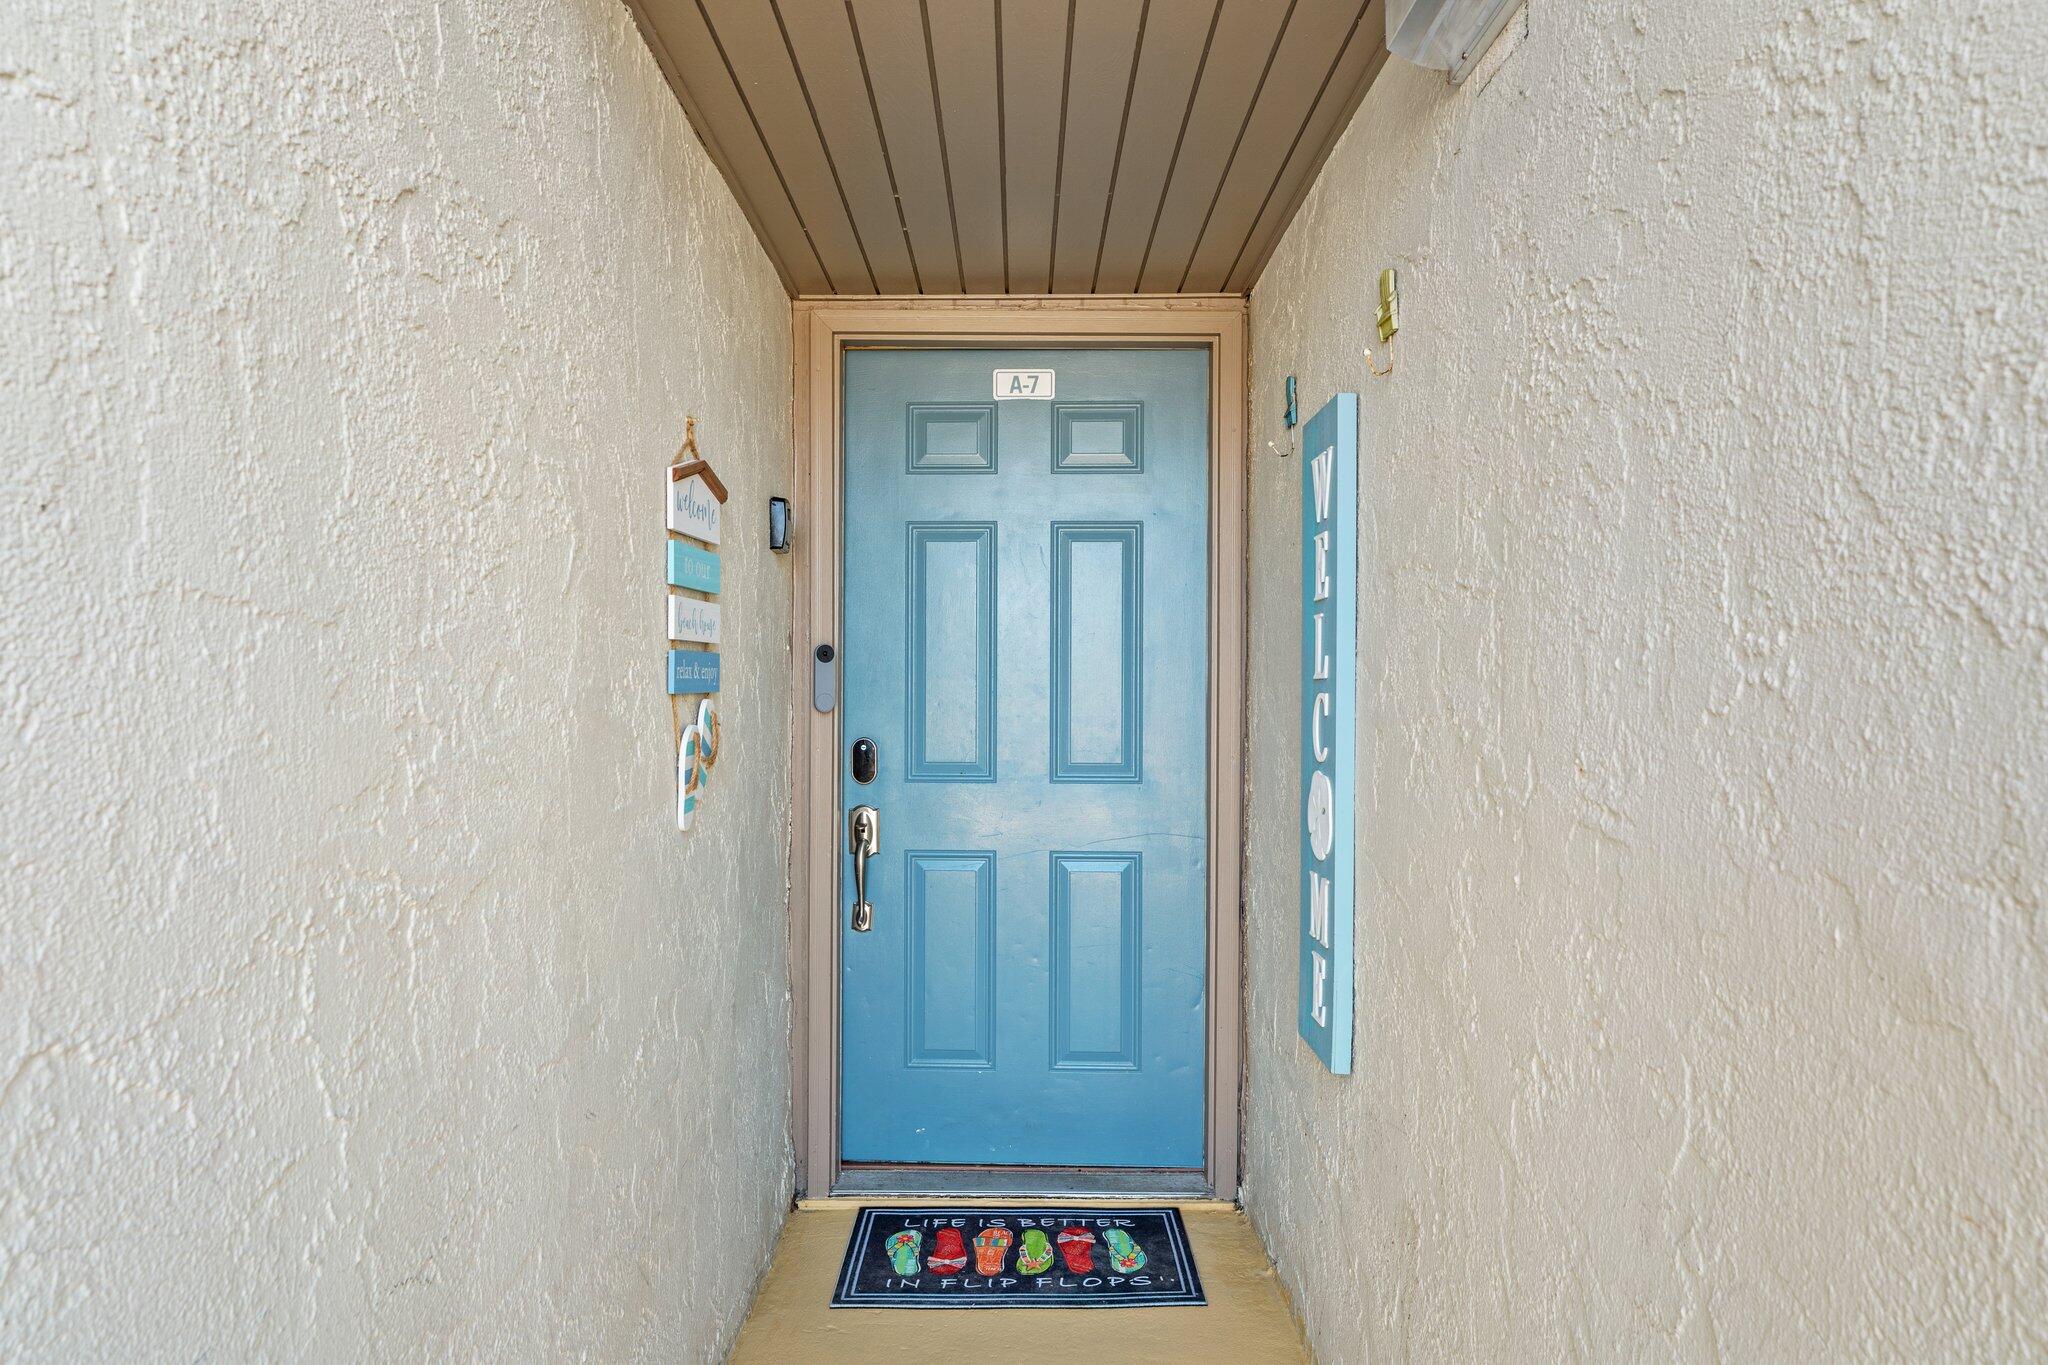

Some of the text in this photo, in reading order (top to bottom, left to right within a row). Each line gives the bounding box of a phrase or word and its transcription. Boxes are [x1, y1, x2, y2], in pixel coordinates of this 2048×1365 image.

[1009, 375, 1039, 394] A-7
[676, 479, 717, 531] welcome
[684, 557, 710, 580] to our
[677, 602, 698, 635] beach
[676, 659, 719, 687] relax & enjoy
[904, 1217, 1136, 1228] LIFE IS BETTER
[886, 1277, 920, 1289] IN
[940, 1277, 1018, 1289] FLIP
